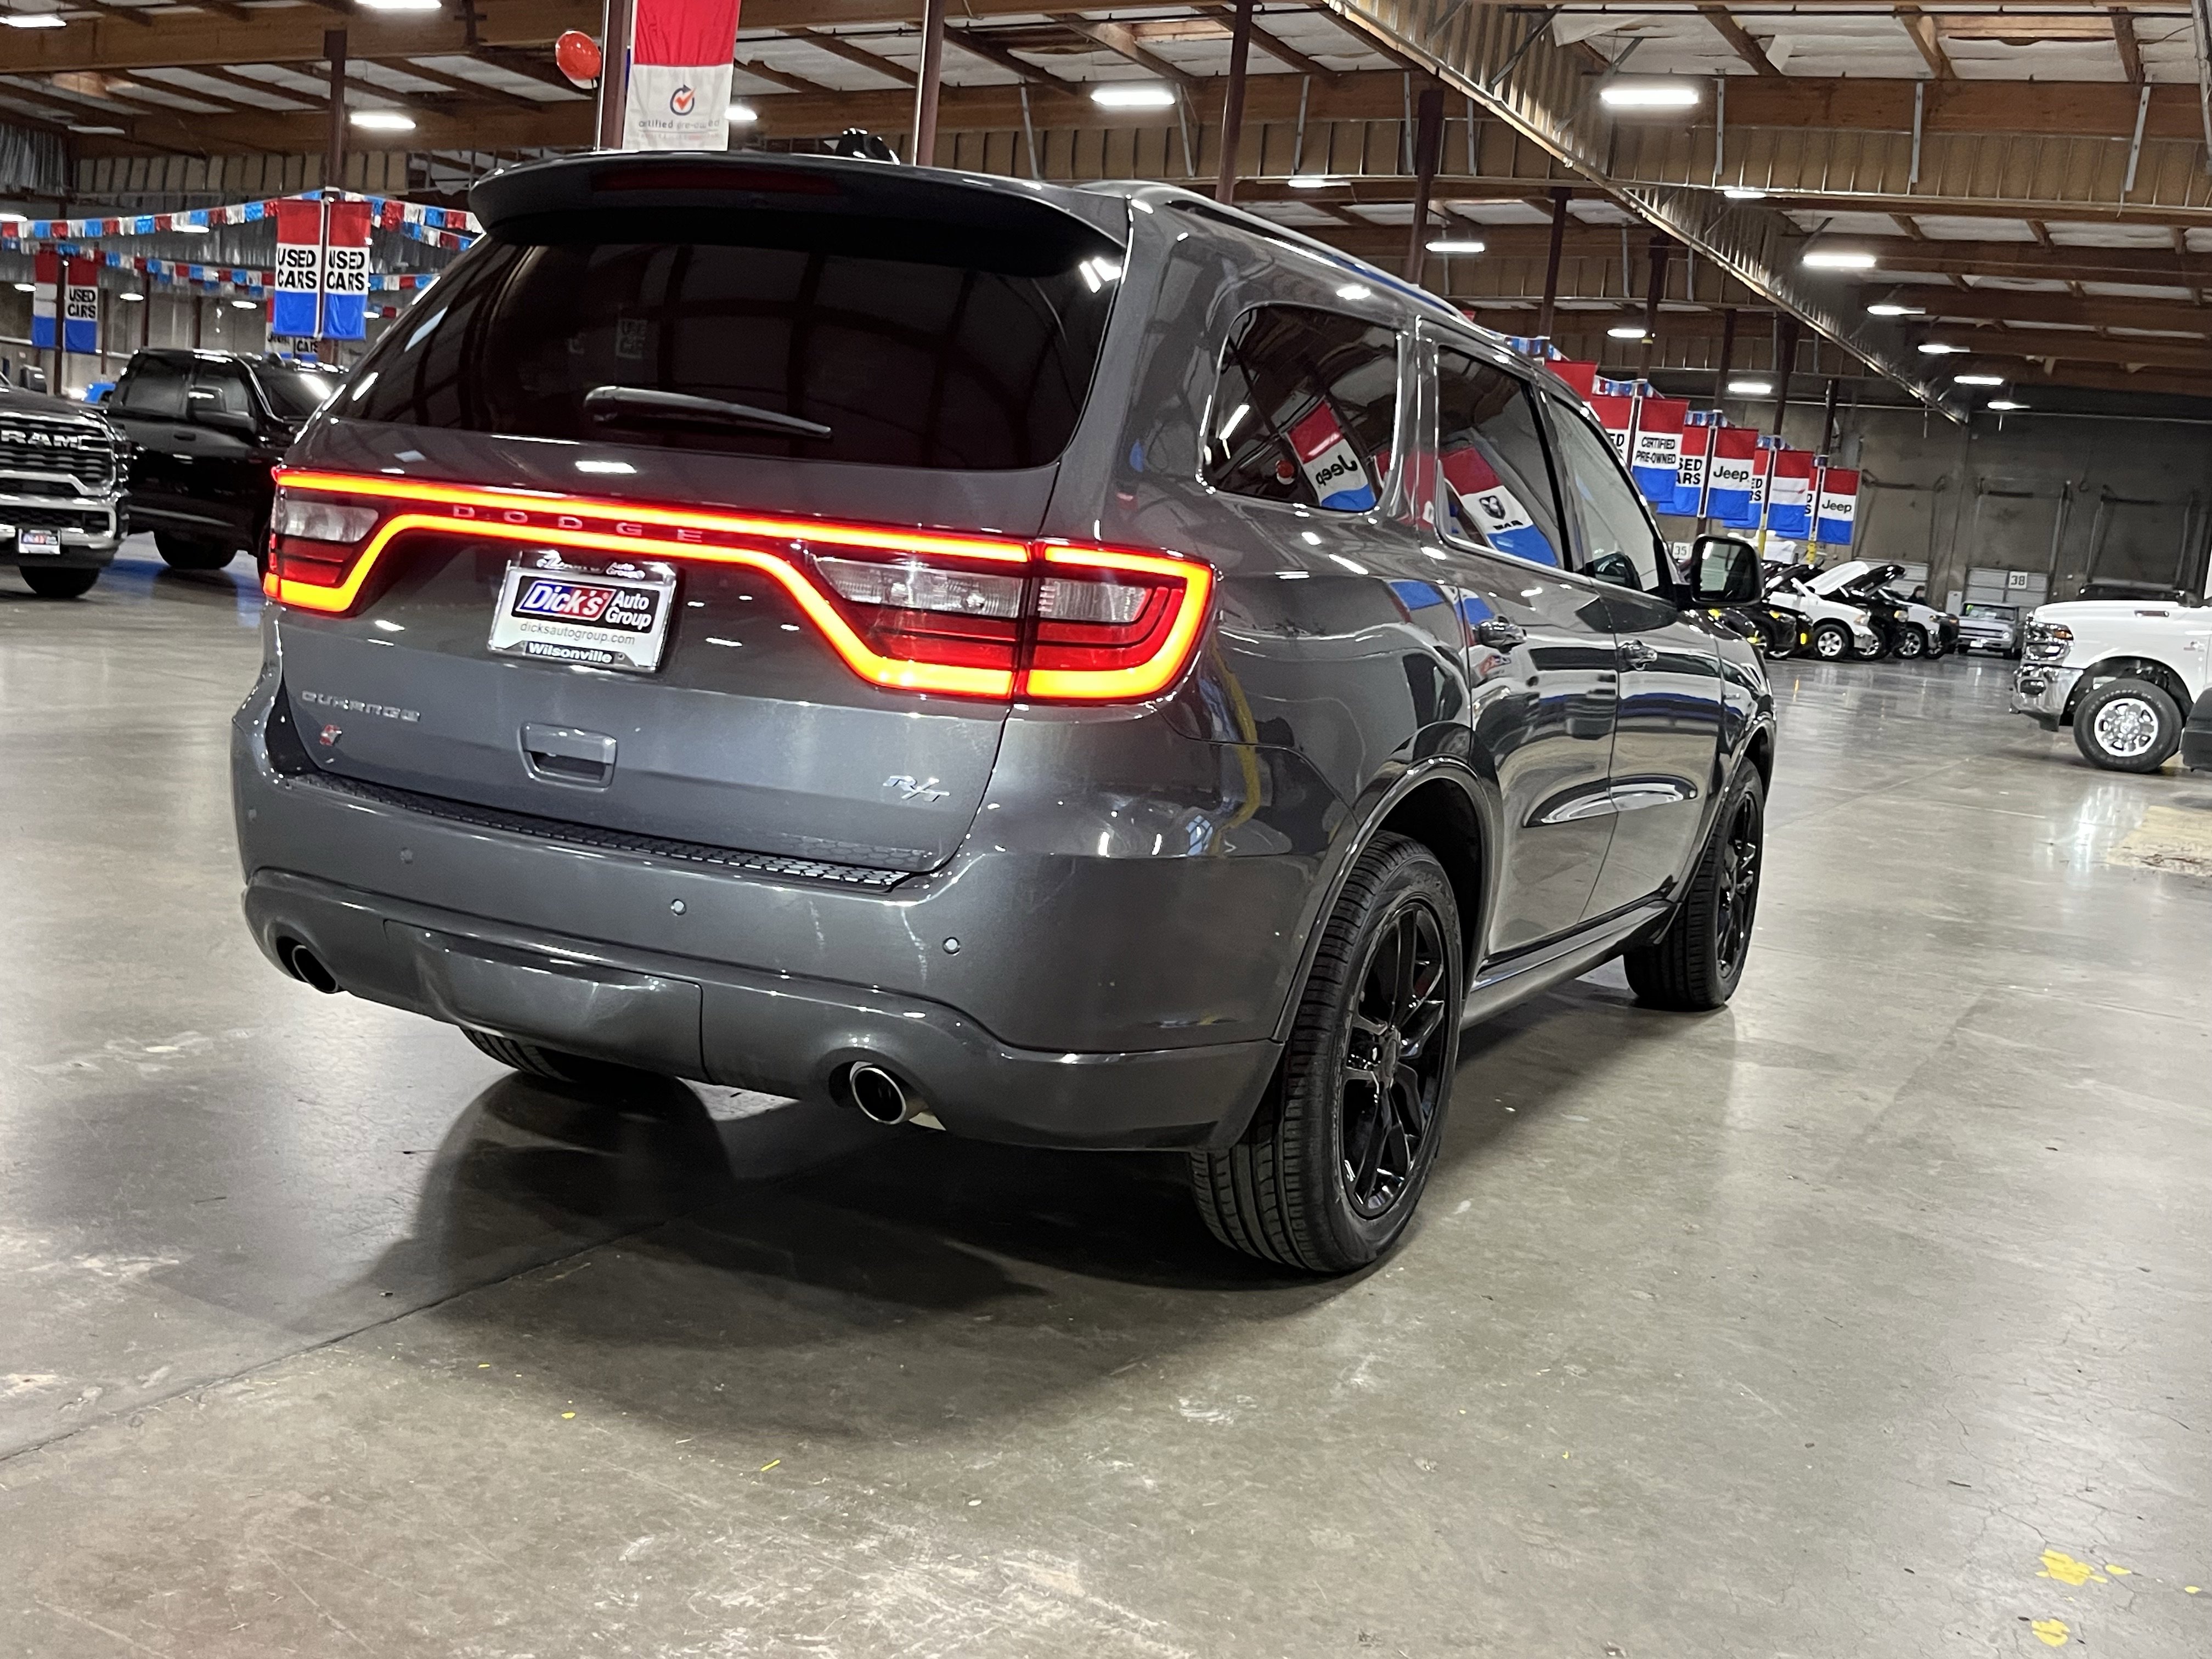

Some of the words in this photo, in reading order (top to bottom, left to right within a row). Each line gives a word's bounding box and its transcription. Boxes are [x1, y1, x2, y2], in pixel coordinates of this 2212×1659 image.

[277, 247, 317, 268] USED
[328, 250, 365, 270] USED
[277, 269, 317, 290] CARS
[326, 270, 365, 291] CARS
[69, 287, 96, 303] USED
[67, 303, 97, 319] CARS
[1, 429, 78, 448] RAM
[1641, 436, 1675, 450] CERTIFIED
[1635, 450, 1677, 464] PRE-OWNED
[1713, 466, 1749, 483] Jeep
[1821, 499, 1852, 514] Jeep
[453, 504, 703, 543] DODGE
[1674, 545, 1687, 556] 35
[2010, 575, 2025, 586] 38
[523, 585, 605, 616] Dick's
[611, 590, 650, 611] Auto
[605, 606, 652, 630] Group
[520, 621, 636, 645] dicksautogroup.com
[528, 642, 613, 664] Wilsonville
